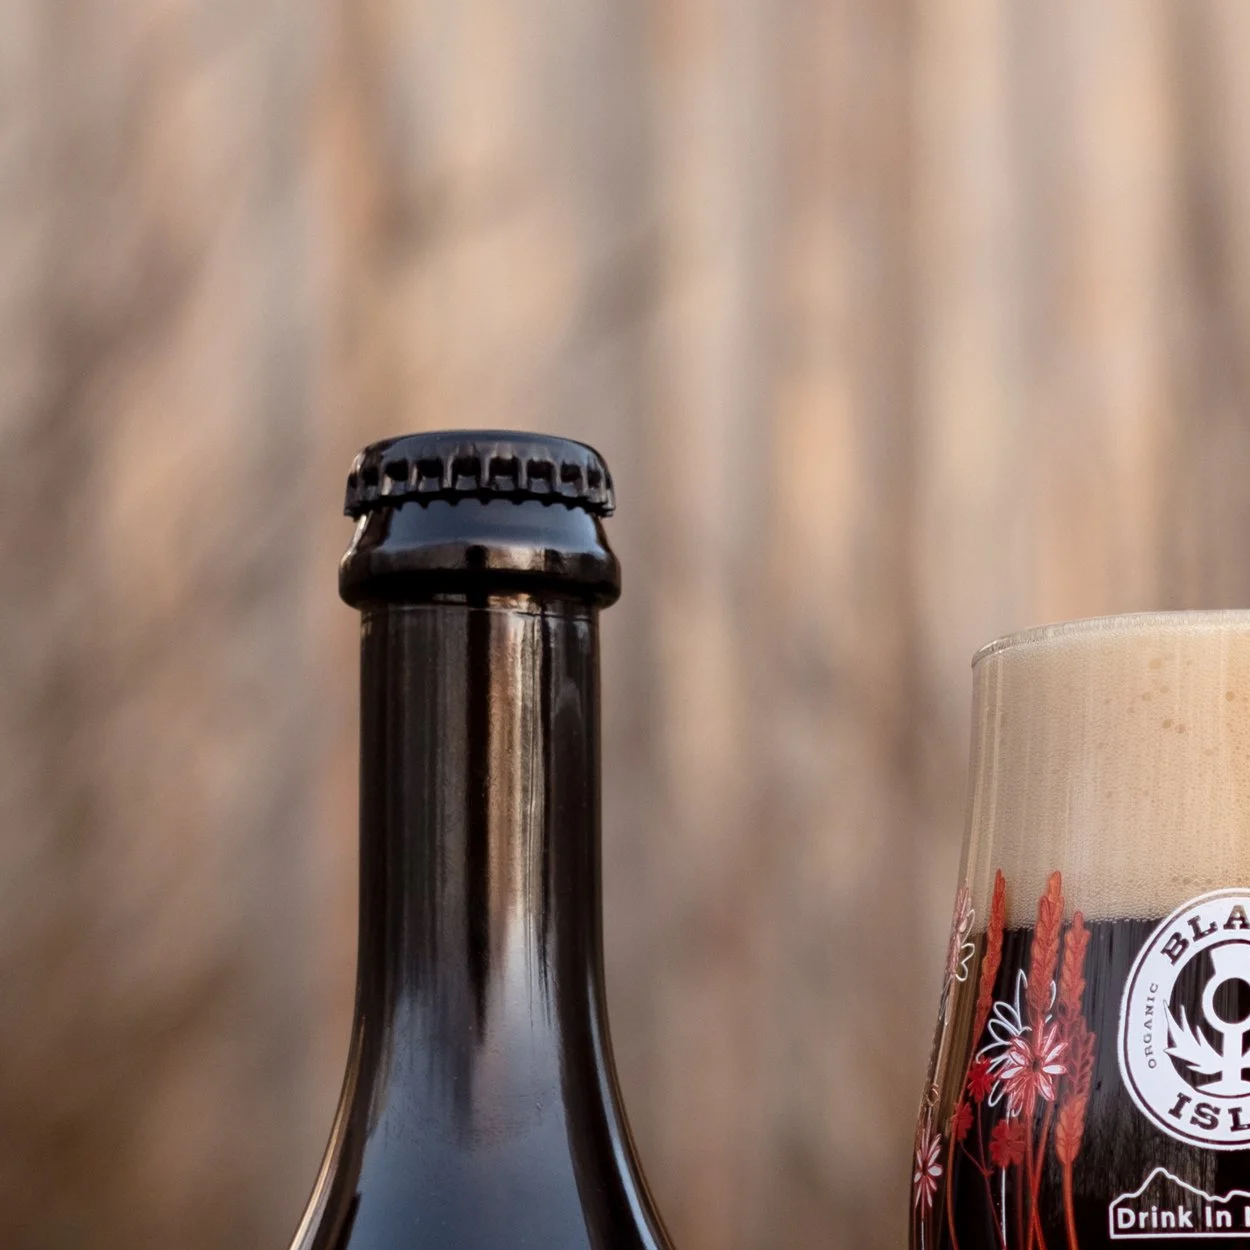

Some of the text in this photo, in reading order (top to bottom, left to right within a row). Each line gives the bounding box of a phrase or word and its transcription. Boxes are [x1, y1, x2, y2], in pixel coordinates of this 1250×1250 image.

[1143, 982, 1159, 1069] ORGANIC
[1117, 1206, 1193, 1229] Drink
[1205, 1206, 1232, 1228] In
